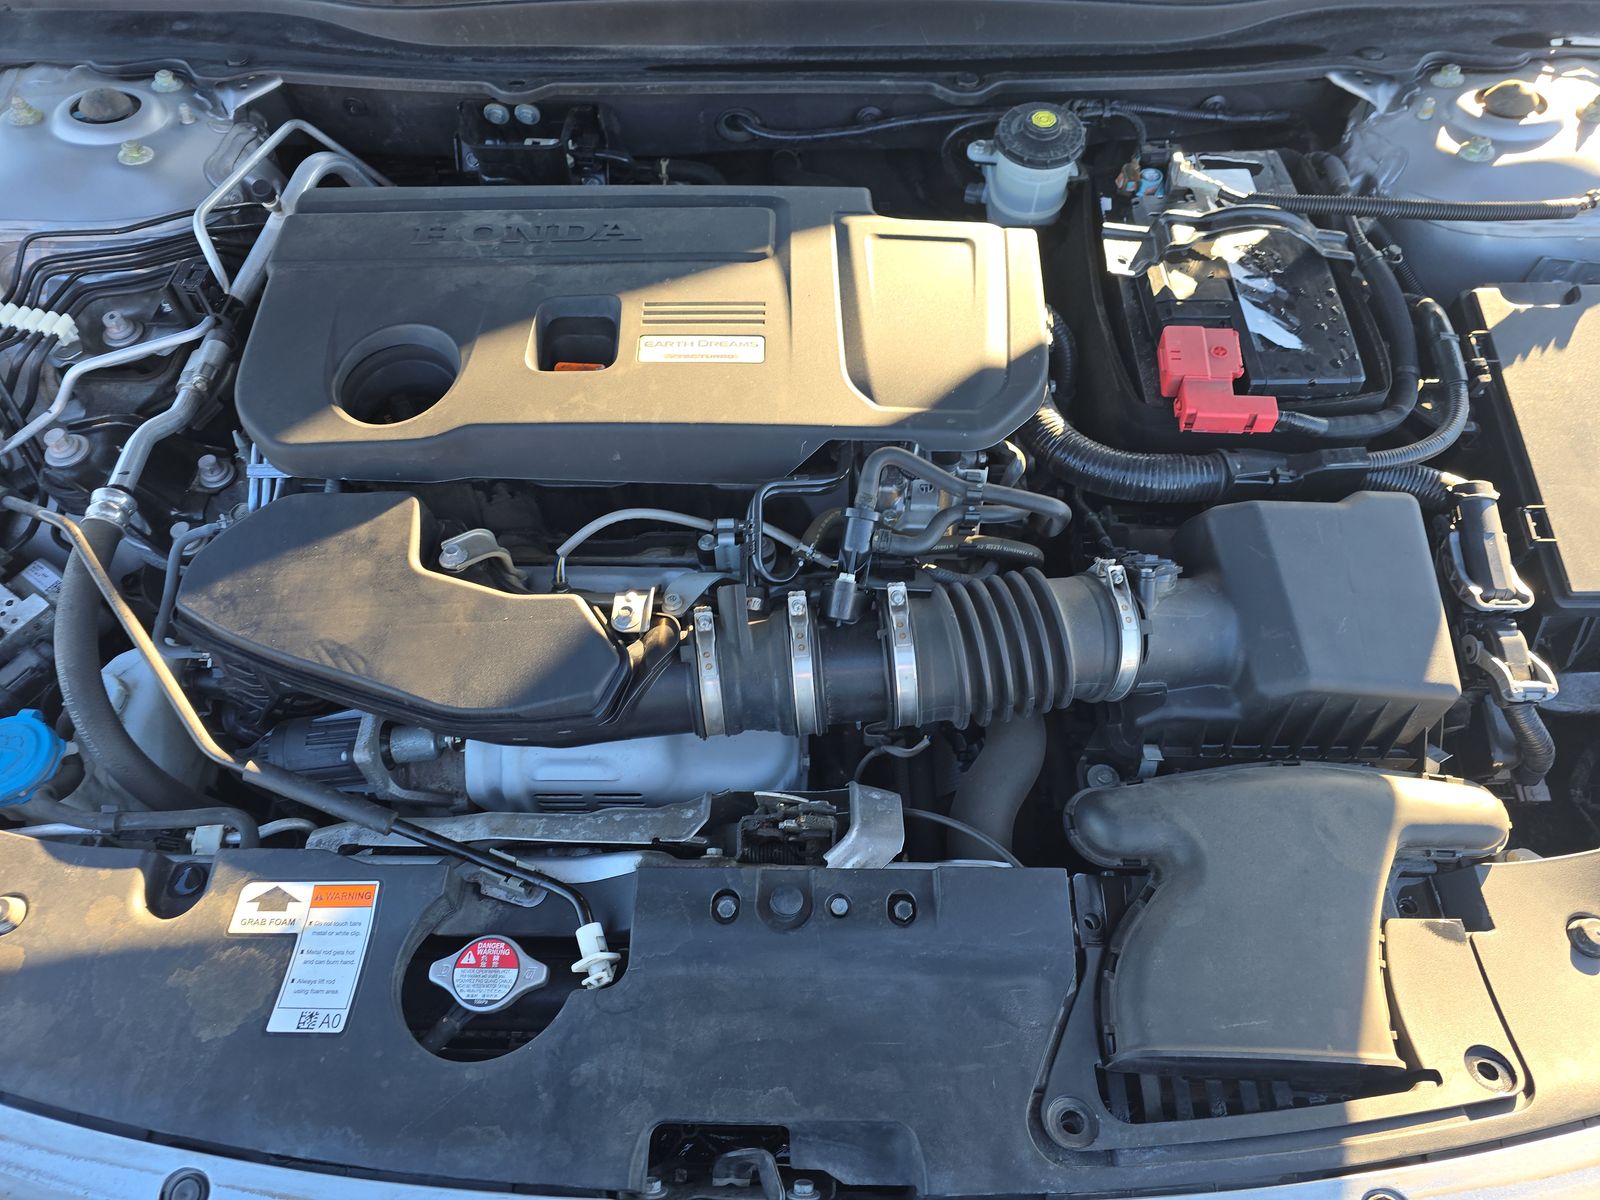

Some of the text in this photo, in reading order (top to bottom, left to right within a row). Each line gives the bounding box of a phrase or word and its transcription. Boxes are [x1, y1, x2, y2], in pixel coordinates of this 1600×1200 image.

[410, 223, 643, 245] HONDA
[326, 891, 372, 900] WARNING
[240, 918, 296, 926] GRAB FOAM
[477, 948, 510, 956] WARNING
[296, 978, 317, 986] Always
[293, 988, 309, 996] using
